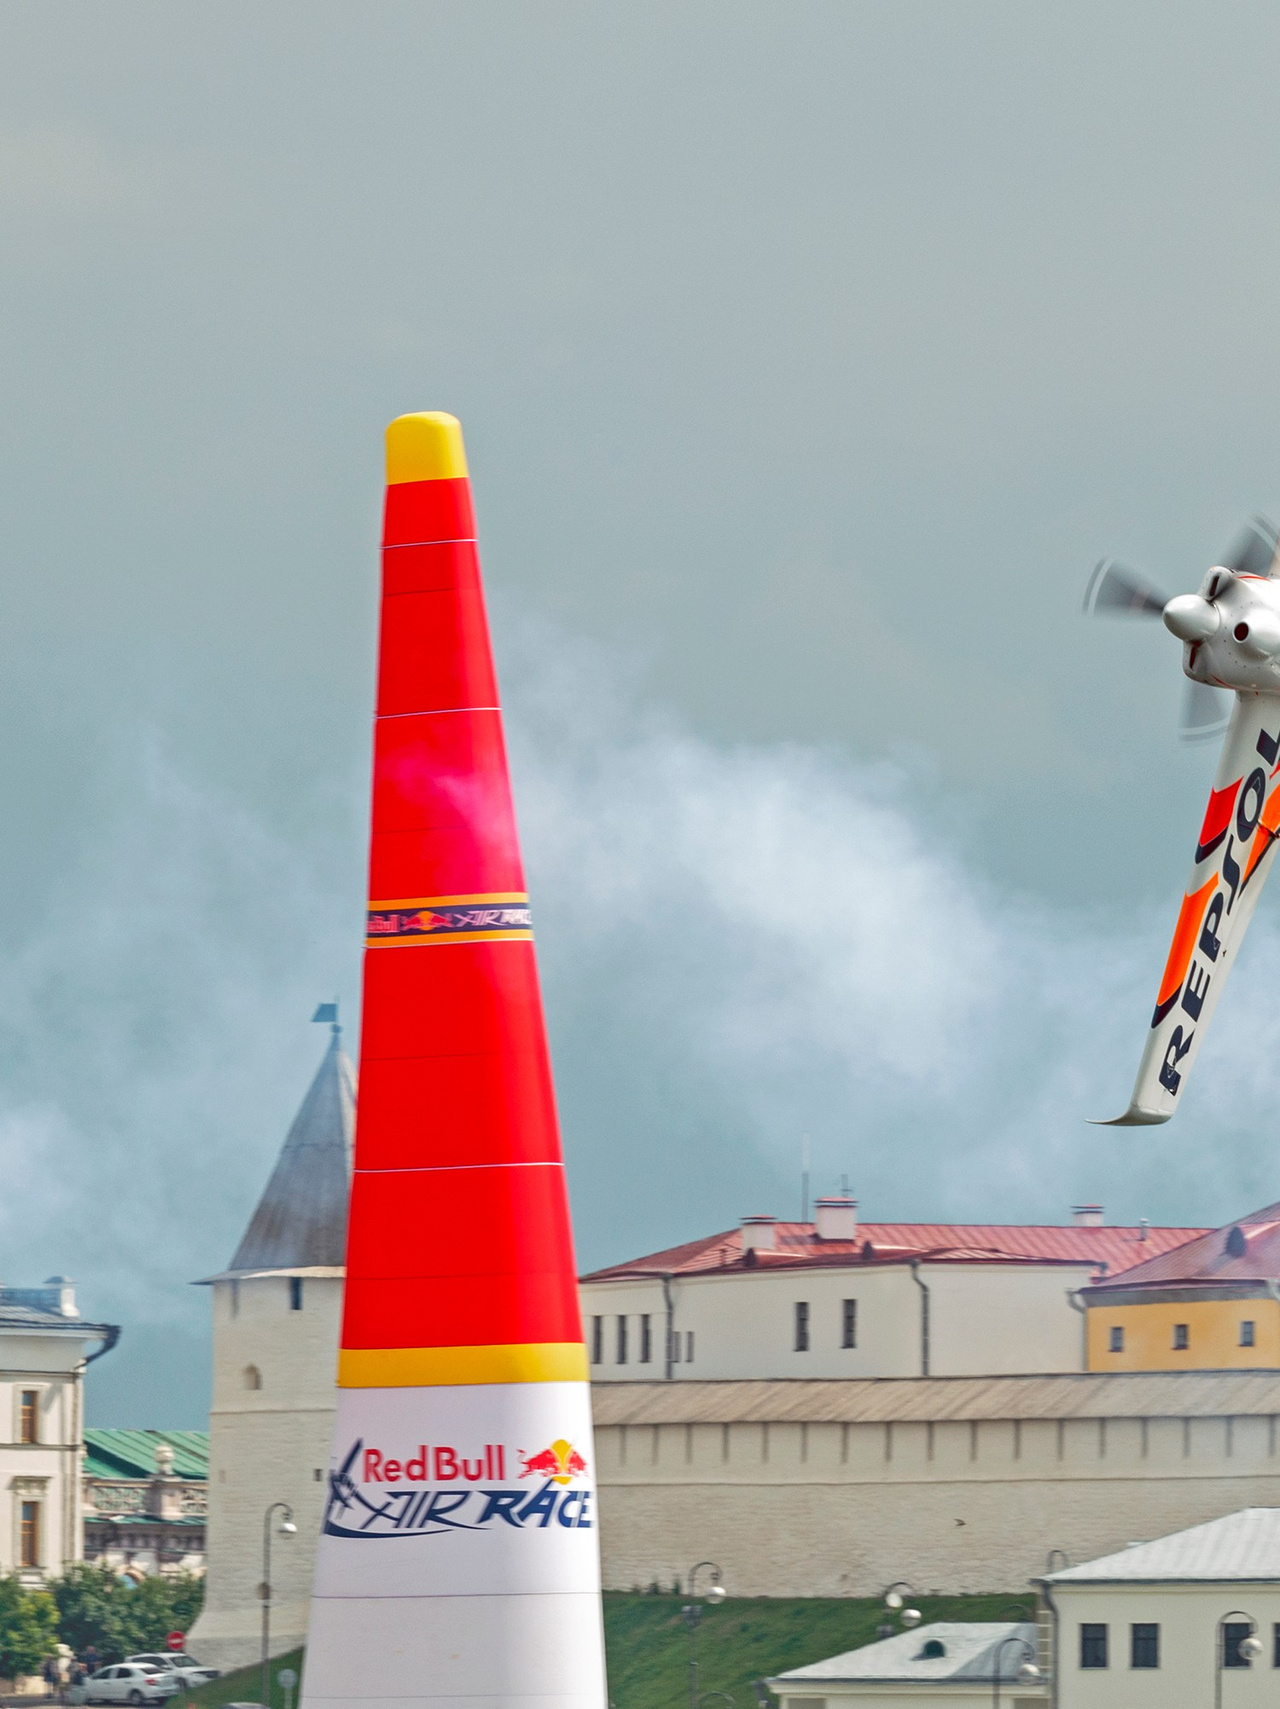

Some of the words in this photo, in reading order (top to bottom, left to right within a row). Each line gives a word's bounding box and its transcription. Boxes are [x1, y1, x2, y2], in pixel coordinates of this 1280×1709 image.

[363, 1444, 428, 1483] Red
[433, 1444, 505, 1481] Bull
[359, 1490, 491, 1530] AIR
[474, 1479, 593, 1529] RACE
